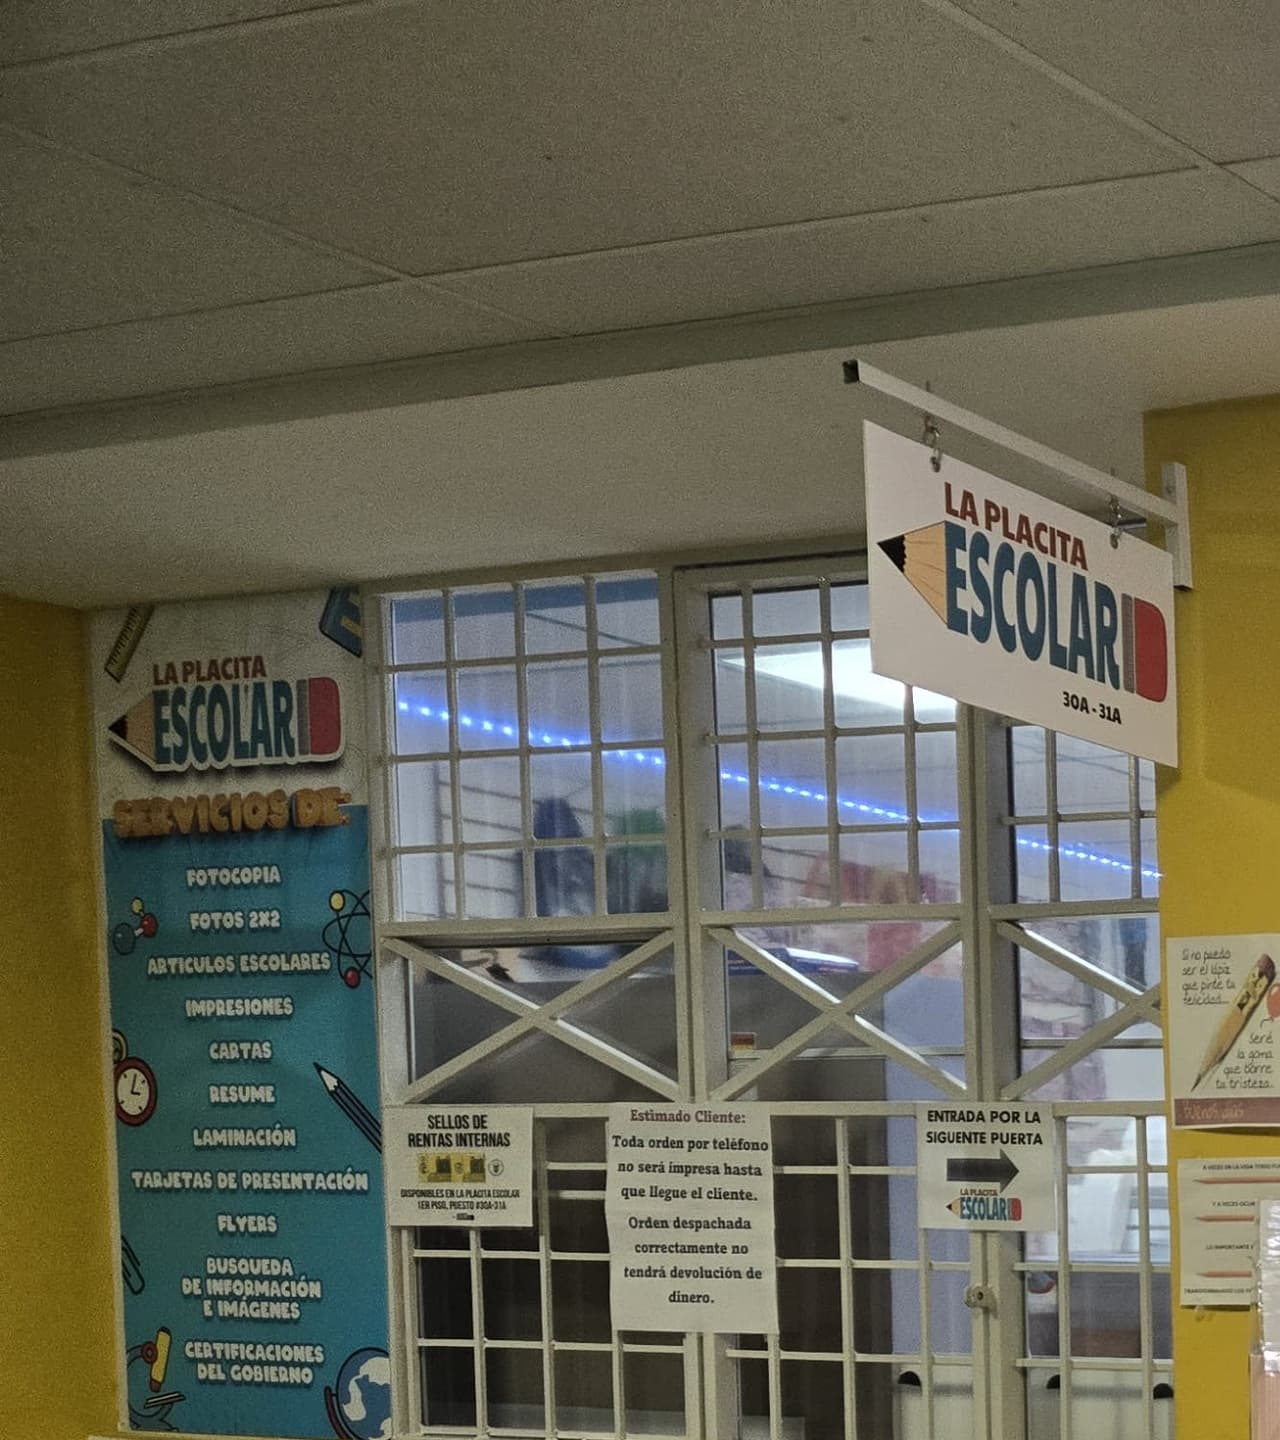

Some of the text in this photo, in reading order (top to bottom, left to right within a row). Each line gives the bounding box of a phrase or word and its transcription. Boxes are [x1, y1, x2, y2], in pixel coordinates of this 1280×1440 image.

[944, 482, 1087, 570] LA PLACITA
[945, 521, 1120, 690] ESCOLAR
[153, 656, 266, 685] LA PLACITA
[152, 679, 297, 765] ESCOLAR
[113, 786, 353, 838] SERVICIOS DE
[187, 865, 280, 887] FOTOCOPIA
[190, 911, 280, 931] FOTOS 2X2
[147, 952, 330, 975] ARTICULOS ESCOLARES
[185, 998, 293, 1017] IMPRESIONES
[209, 1042, 272, 1060] CARTAS
[209, 1086, 275, 1103] RESUME
[428, 1115, 488, 1130] SELLOS DE
[630, 1110, 745, 1124] Estimado Cliente:
[928, 1110, 1040, 1123] ENTRADA POR LA
[193, 1123, 296, 1146] LAMINACIÓN
[408, 1132, 511, 1148] RENTAS INTERNAS
[926, 1132, 1042, 1145] SIGUENTE PUERTA
[132, 1168, 368, 1190] TARJETAS DE PRESENTACIÓN
[960, 1198, 1007, 1220] ESCOLAR
[217, 1215, 277, 1232] FLYERS
[628, 1217, 751, 1232] Orden despachada
[635, 1242, 748, 1255] correctamente no
[207, 1258, 293, 1276] BUSQUEDA
[669, 1291, 714, 1304] dinero.
[185, 1342, 324, 1362] CERTIFICACIONES
